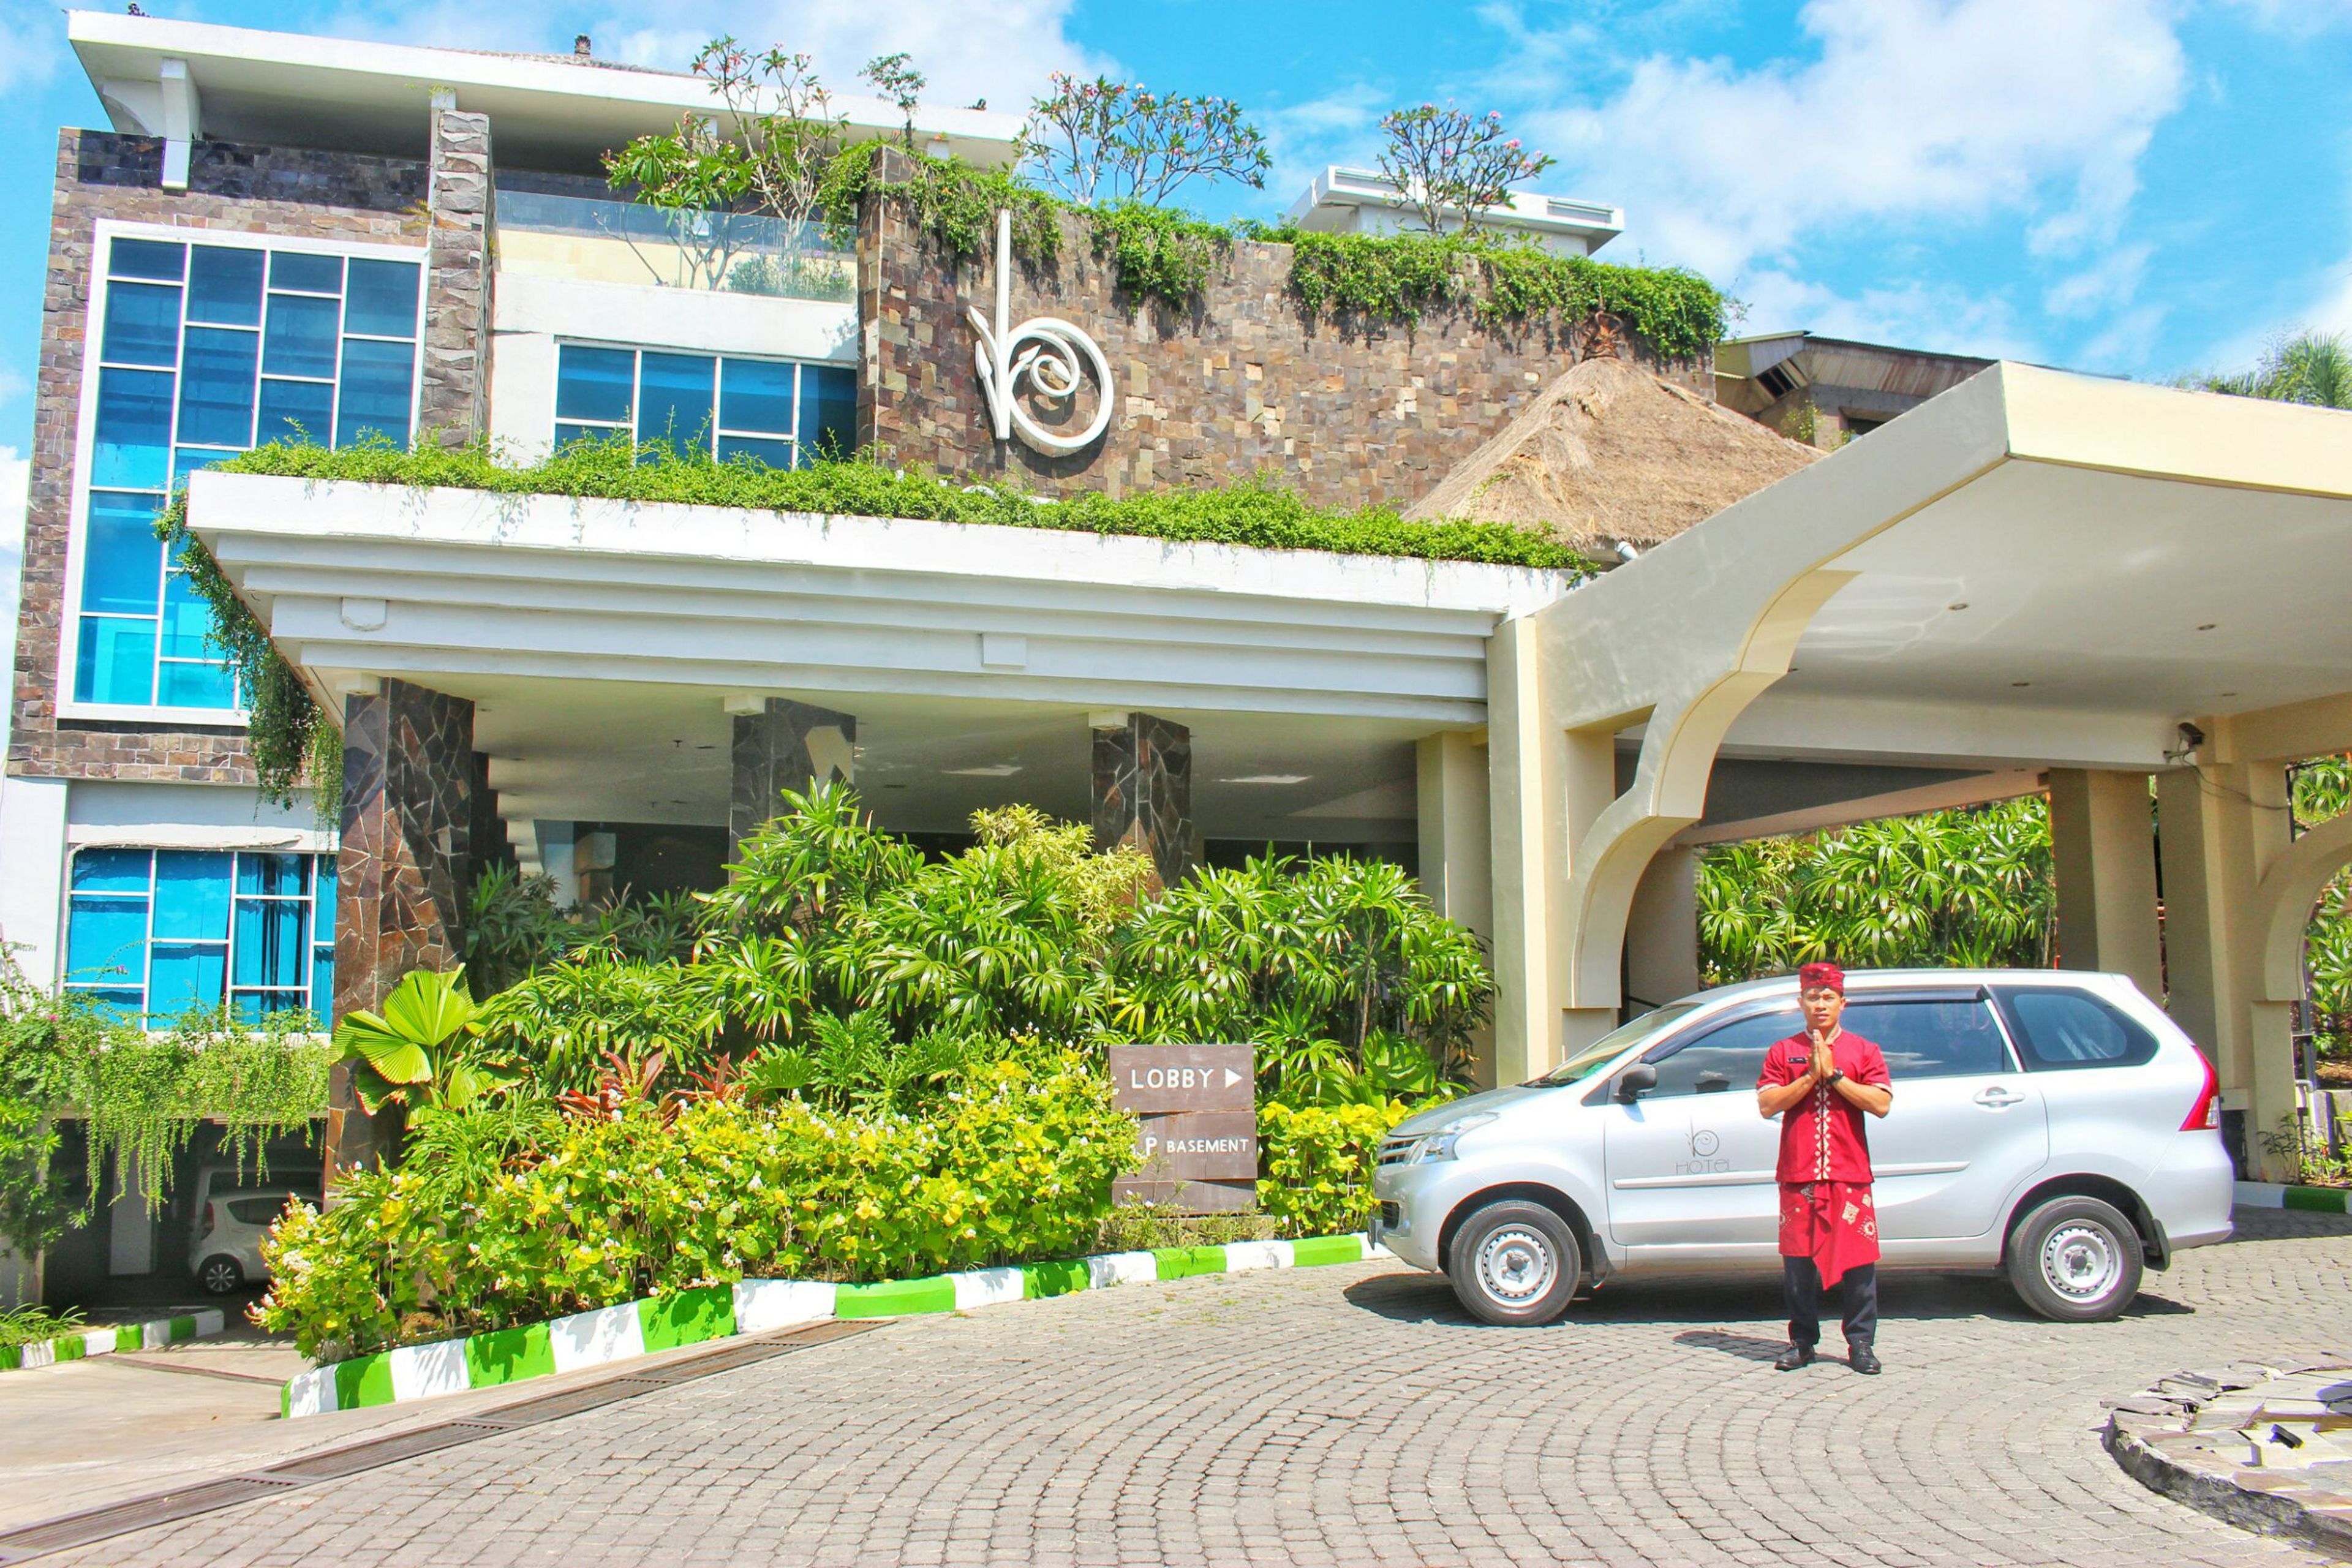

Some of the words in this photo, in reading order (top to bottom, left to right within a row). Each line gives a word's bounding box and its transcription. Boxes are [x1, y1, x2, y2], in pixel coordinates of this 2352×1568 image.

[1131, 1068, 1213, 1088] LOBBY
[1145, 1137, 1157, 1156] P
[1167, 1139, 1250, 1153] BASEMENT
